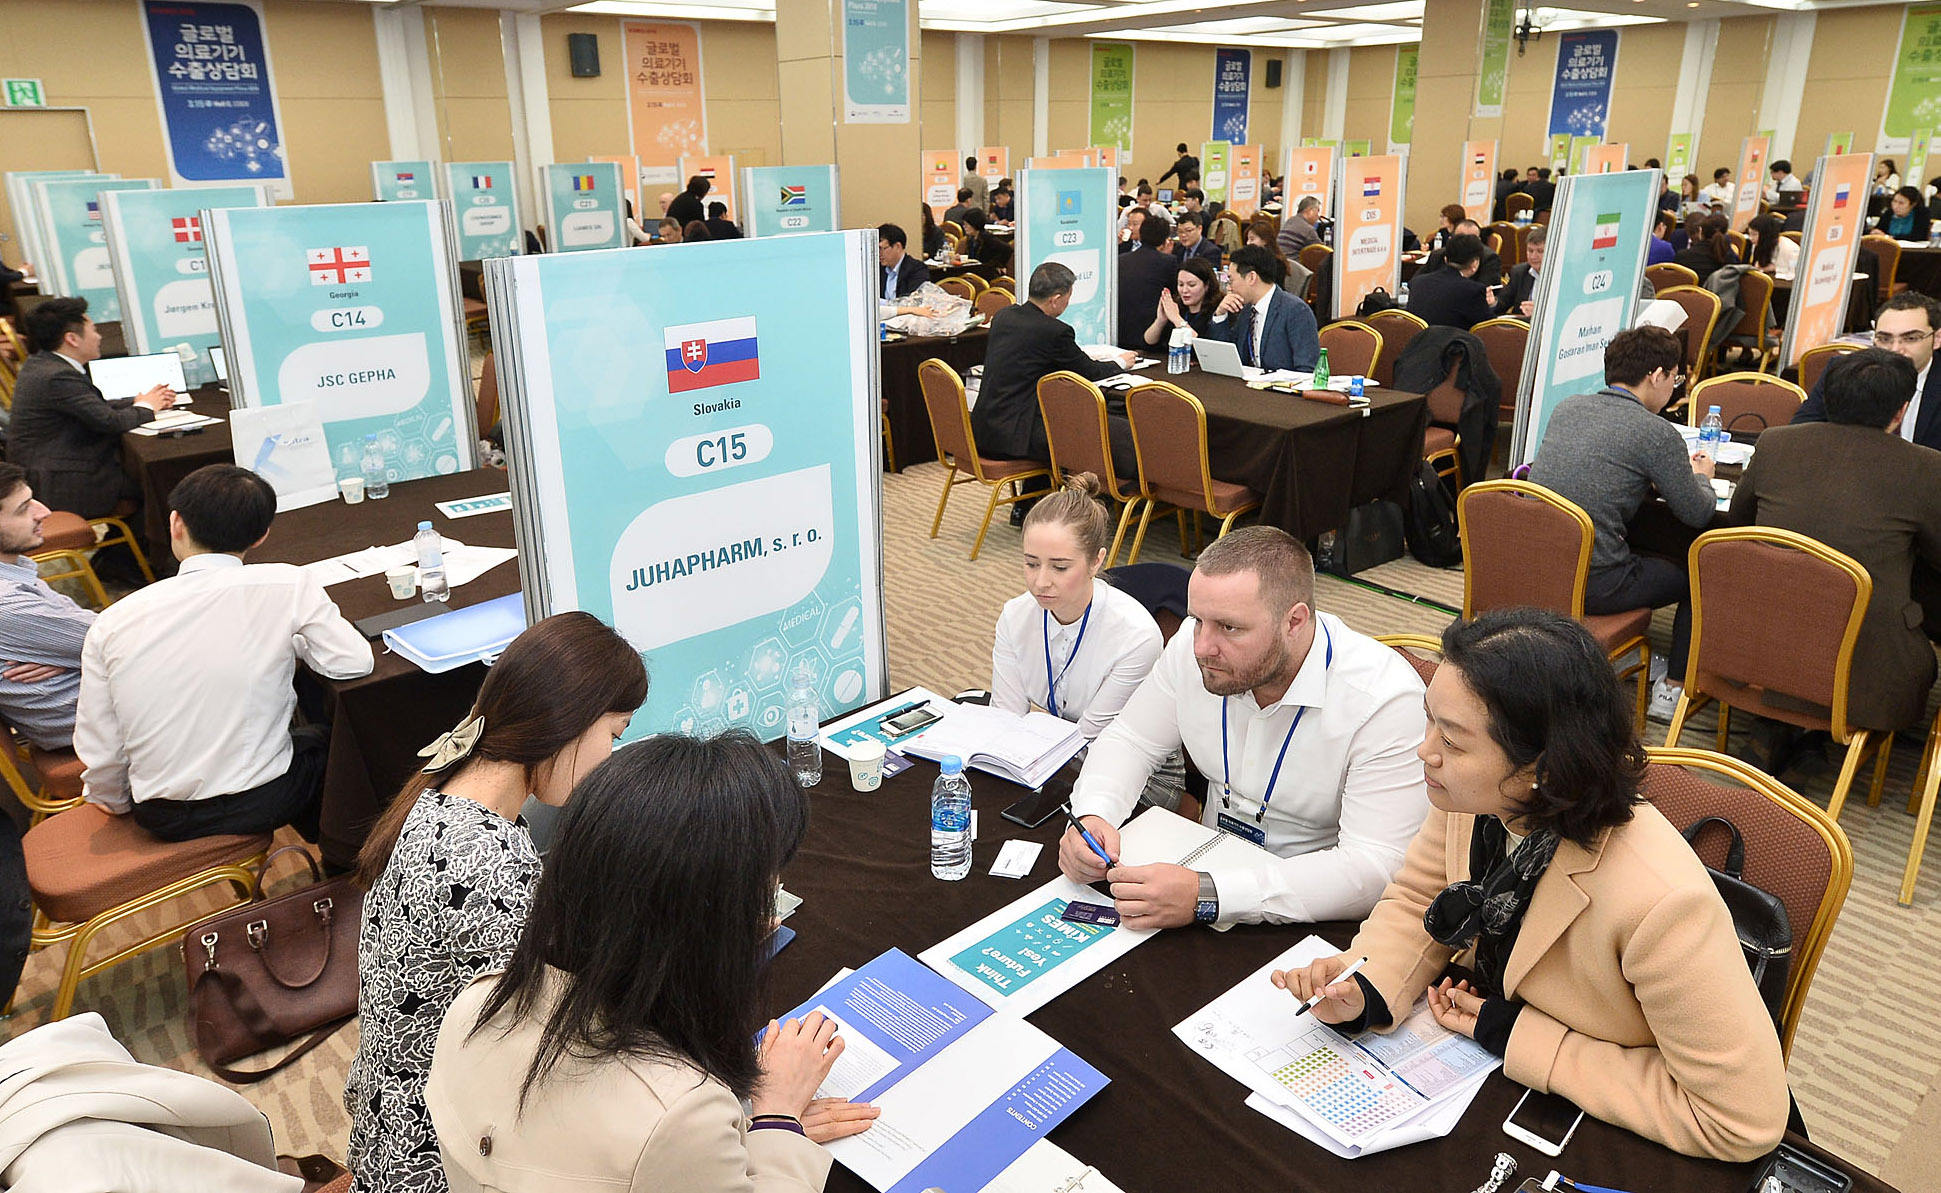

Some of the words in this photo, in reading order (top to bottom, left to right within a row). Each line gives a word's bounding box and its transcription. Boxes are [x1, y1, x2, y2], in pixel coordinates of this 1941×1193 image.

[179, 23, 235, 44] 글로벌
[174, 43, 246, 61] 의료기기
[646, 41, 680, 56] 글로벌
[1574, 44, 1602, 57] 글로벌
[642, 57, 687, 70] 의료기기
[1567, 55, 1605, 67] 의료기기
[168, 61, 258, 80] 수출상담회
[637, 71, 693, 86] 수출상담회
[1561, 66, 1608, 80] 수출상담회
[787, 217, 802, 227] C22
[1062, 232, 1077, 244] C23
[190, 260, 206, 271] C1
[1591, 273, 1607, 291] C24
[329, 290, 359, 300] Georgia
[331, 310, 366, 328] C14
[1577, 325, 1602, 339] Mahan
[317, 374, 345, 388] JSC
[349, 368, 396, 385] GEPHA
[693, 397, 742, 416] Slovakia
[696, 432, 747, 468] C15
[626, 537, 768, 592] JUHAPHARM,
[772, 535, 787, 552] s.
[791, 531, 802, 547] r.
[806, 526, 822, 543] o.
[782, 606, 822, 631] MEDICAL
[981, 946, 1032, 978] Future?
[1017, 947, 1047, 968] Yes!
[975, 963, 1013, 990] Think
[1006, 1107, 1038, 1130] CONTENTS
